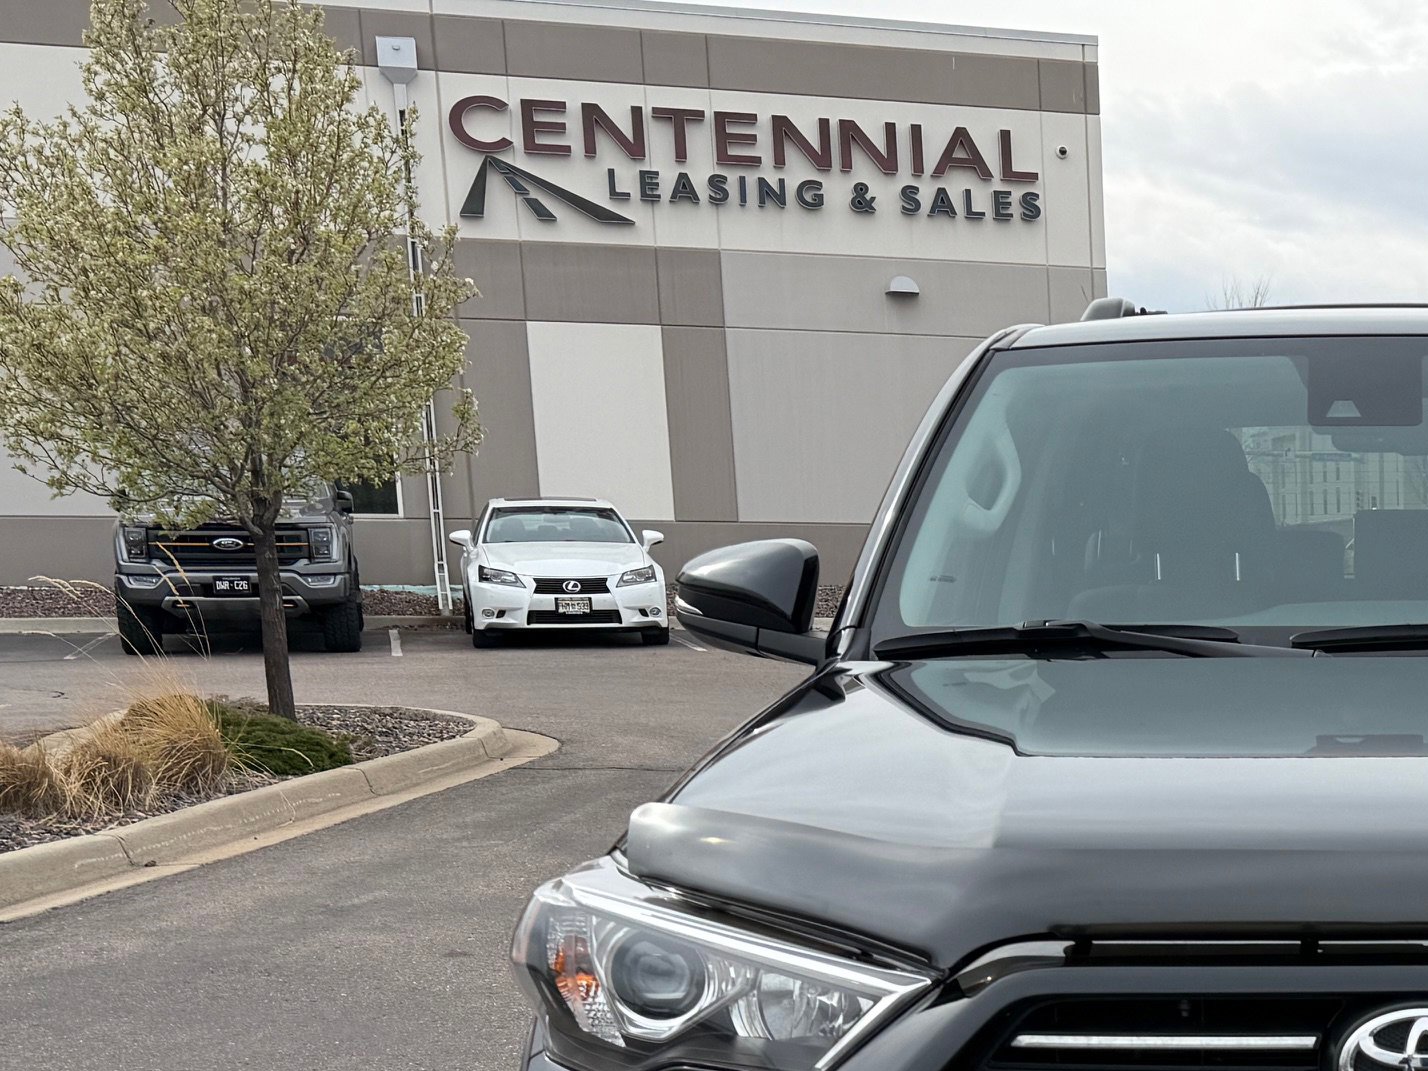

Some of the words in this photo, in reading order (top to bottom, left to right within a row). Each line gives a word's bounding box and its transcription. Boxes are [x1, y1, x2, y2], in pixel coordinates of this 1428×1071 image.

[448, 95, 1039, 182] CENTENNIAL
[607, 168, 825, 211] LEASING
[850, 182, 877, 213] &
[901, 184, 1042, 221] SALES
